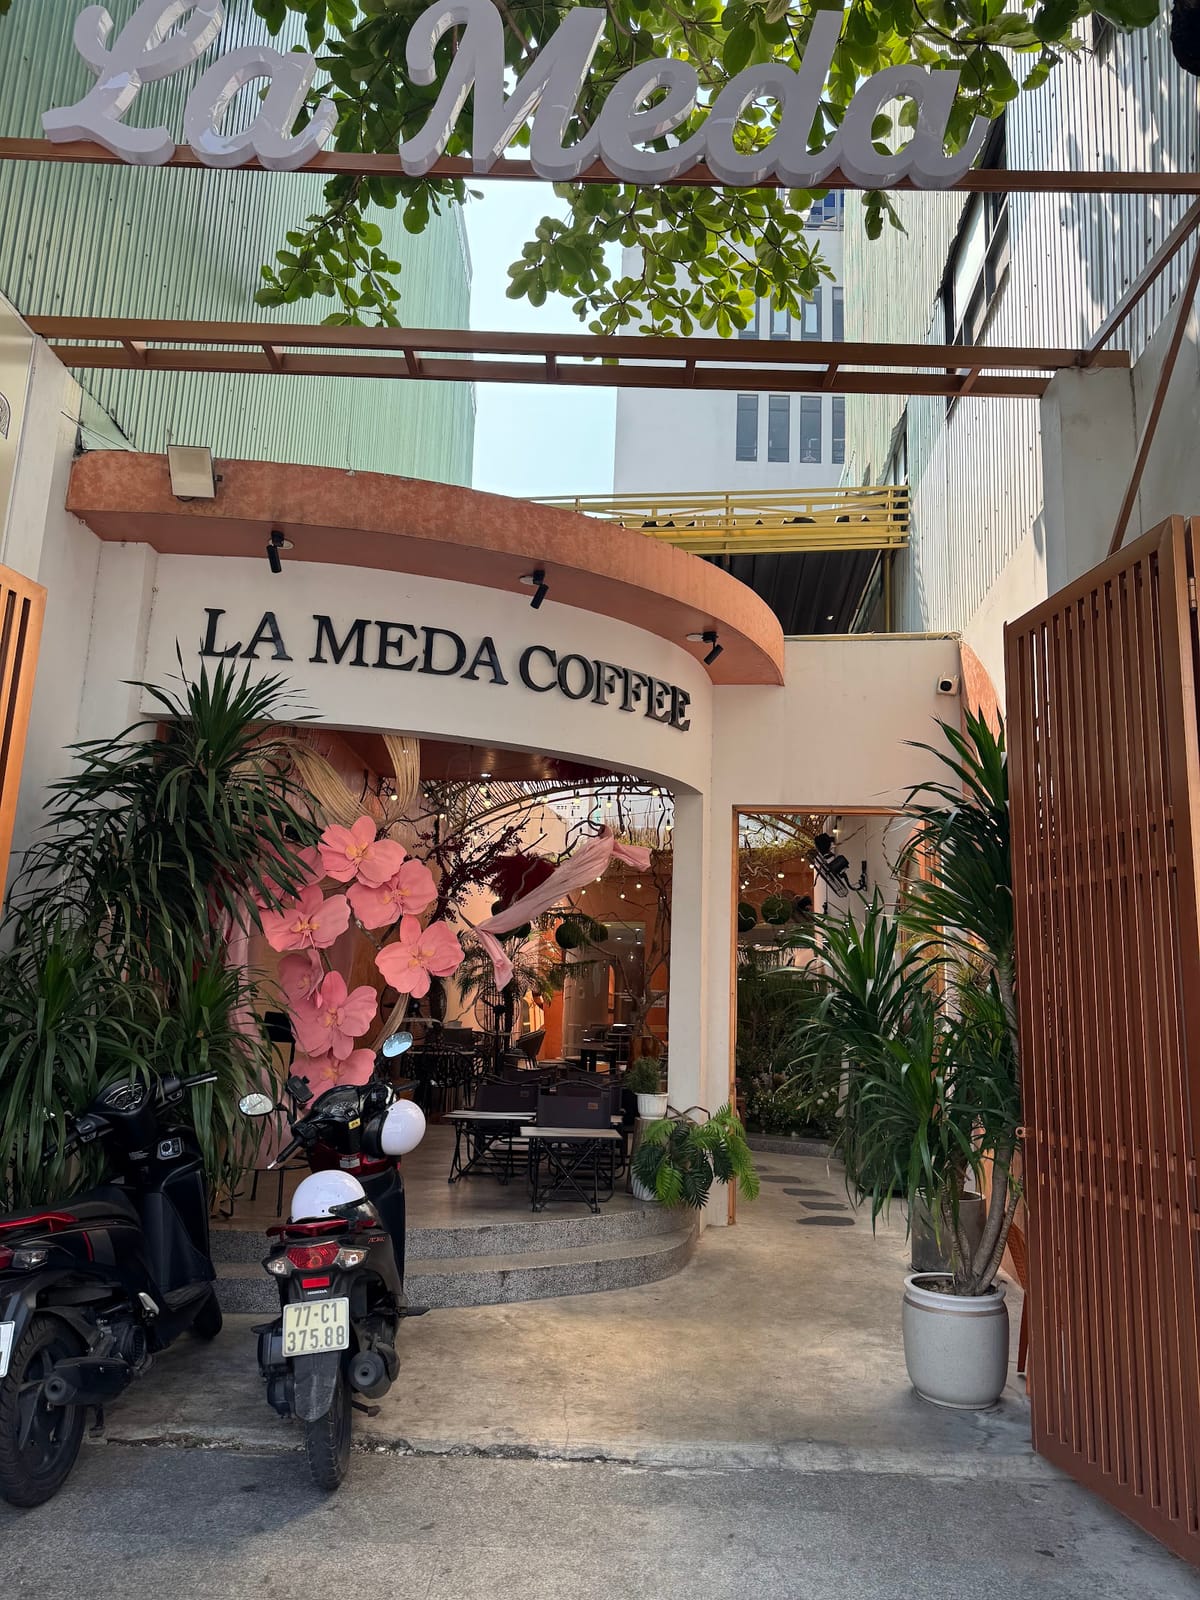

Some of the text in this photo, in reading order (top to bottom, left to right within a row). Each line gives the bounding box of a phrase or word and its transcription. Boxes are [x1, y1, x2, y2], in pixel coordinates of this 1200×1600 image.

[41, 0, 991, 189] La Meda
[198, 607, 691, 731] LA MEDA COFFEE
[287, 1325, 345, 1352] 375.88
[294, 1302, 338, 1328] 77-C1
